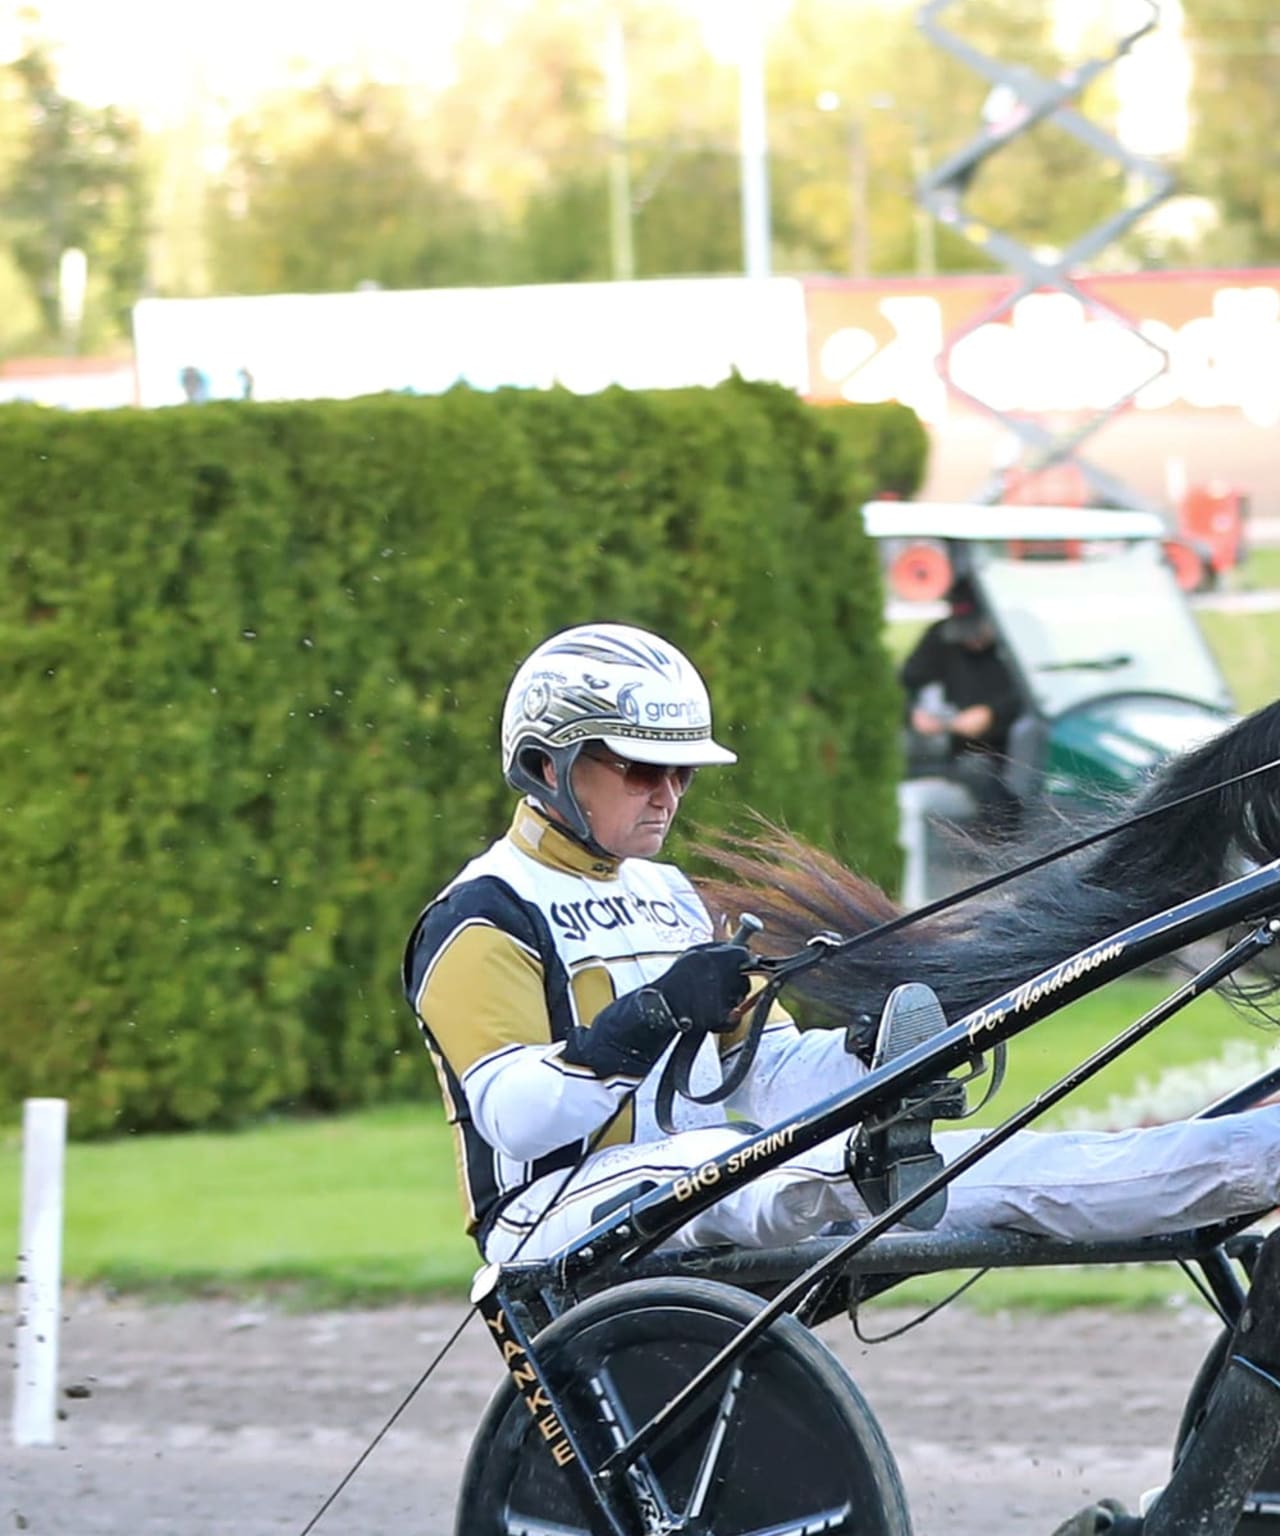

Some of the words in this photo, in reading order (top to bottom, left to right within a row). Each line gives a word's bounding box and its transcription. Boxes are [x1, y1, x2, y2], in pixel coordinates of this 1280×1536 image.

[966, 1008, 1006, 1045] Per
[727, 1123, 801, 1174] SPRINT
[488, 1310, 576, 1467] YANKEE
